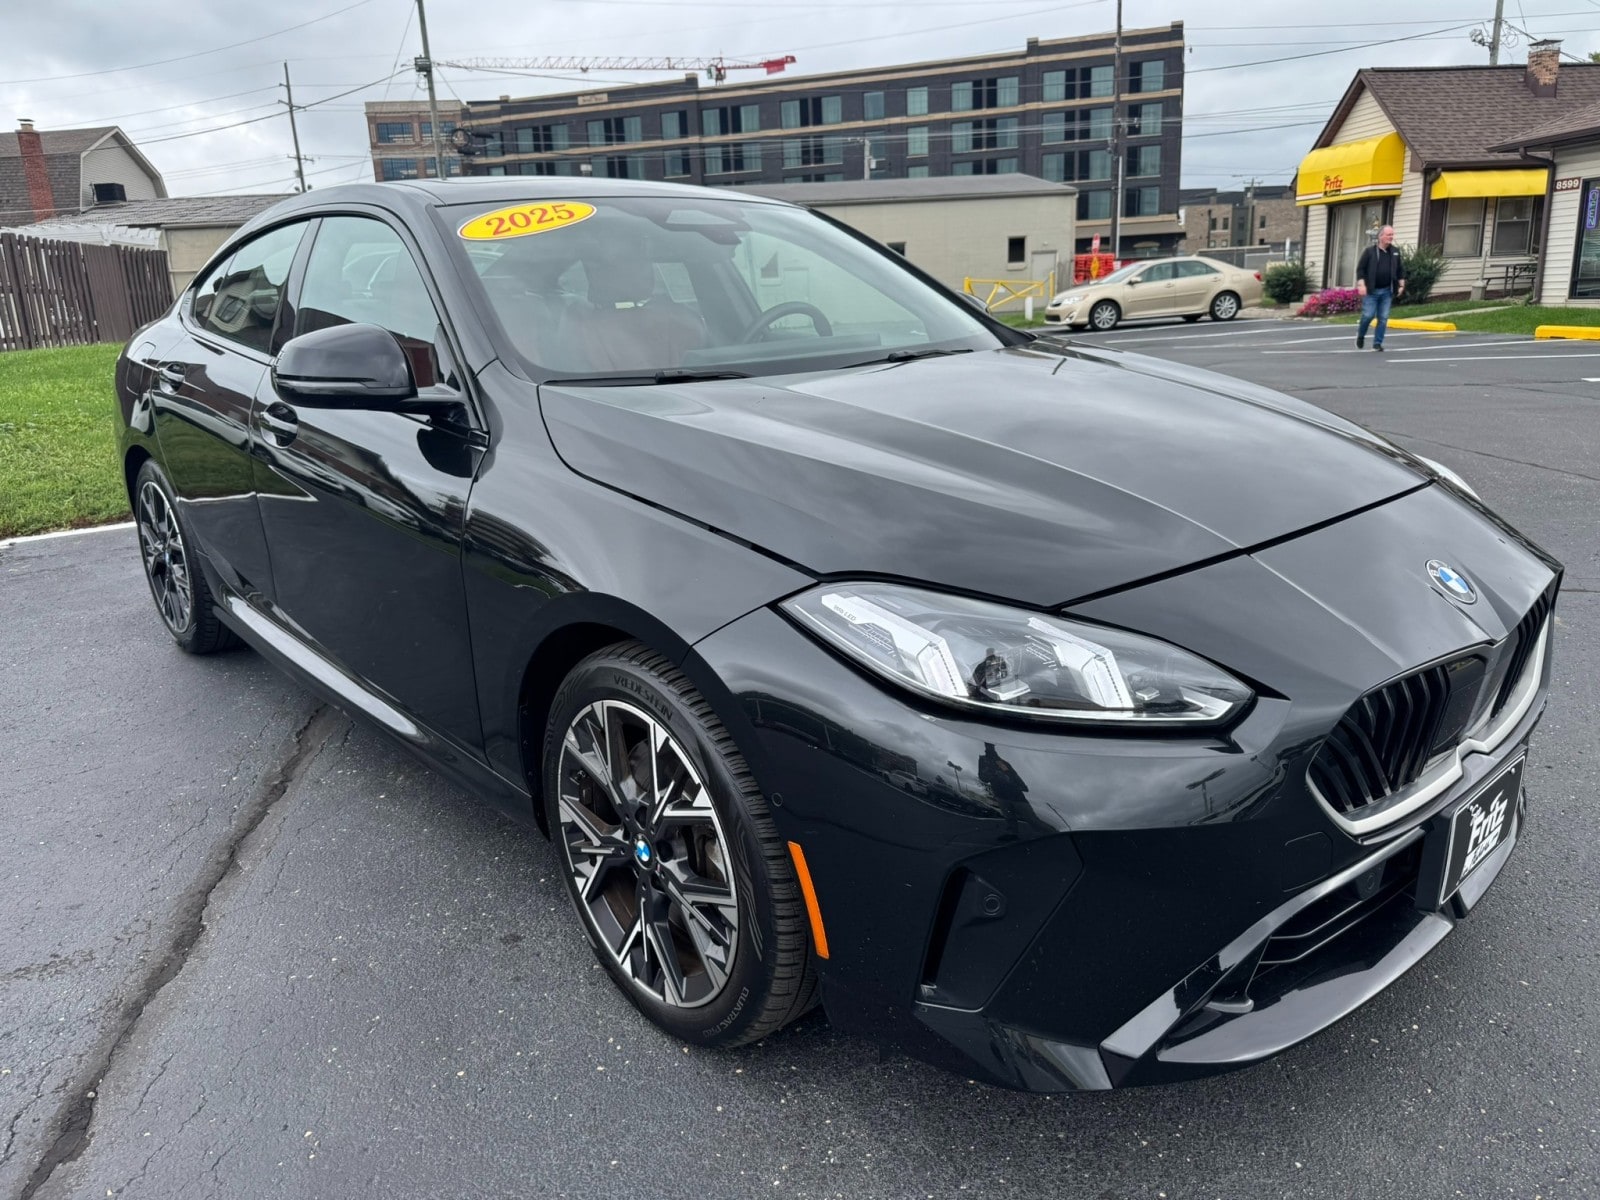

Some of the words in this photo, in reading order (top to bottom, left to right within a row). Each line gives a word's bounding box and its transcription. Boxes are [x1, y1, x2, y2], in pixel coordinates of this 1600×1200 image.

[1323, 176, 1344, 191] Fritz
[1556, 179, 1579, 190] 8599
[485, 204, 575, 236] 2025
[1589, 191, 1597, 226] OPEN
[1467, 790, 1508, 855] Fritz
